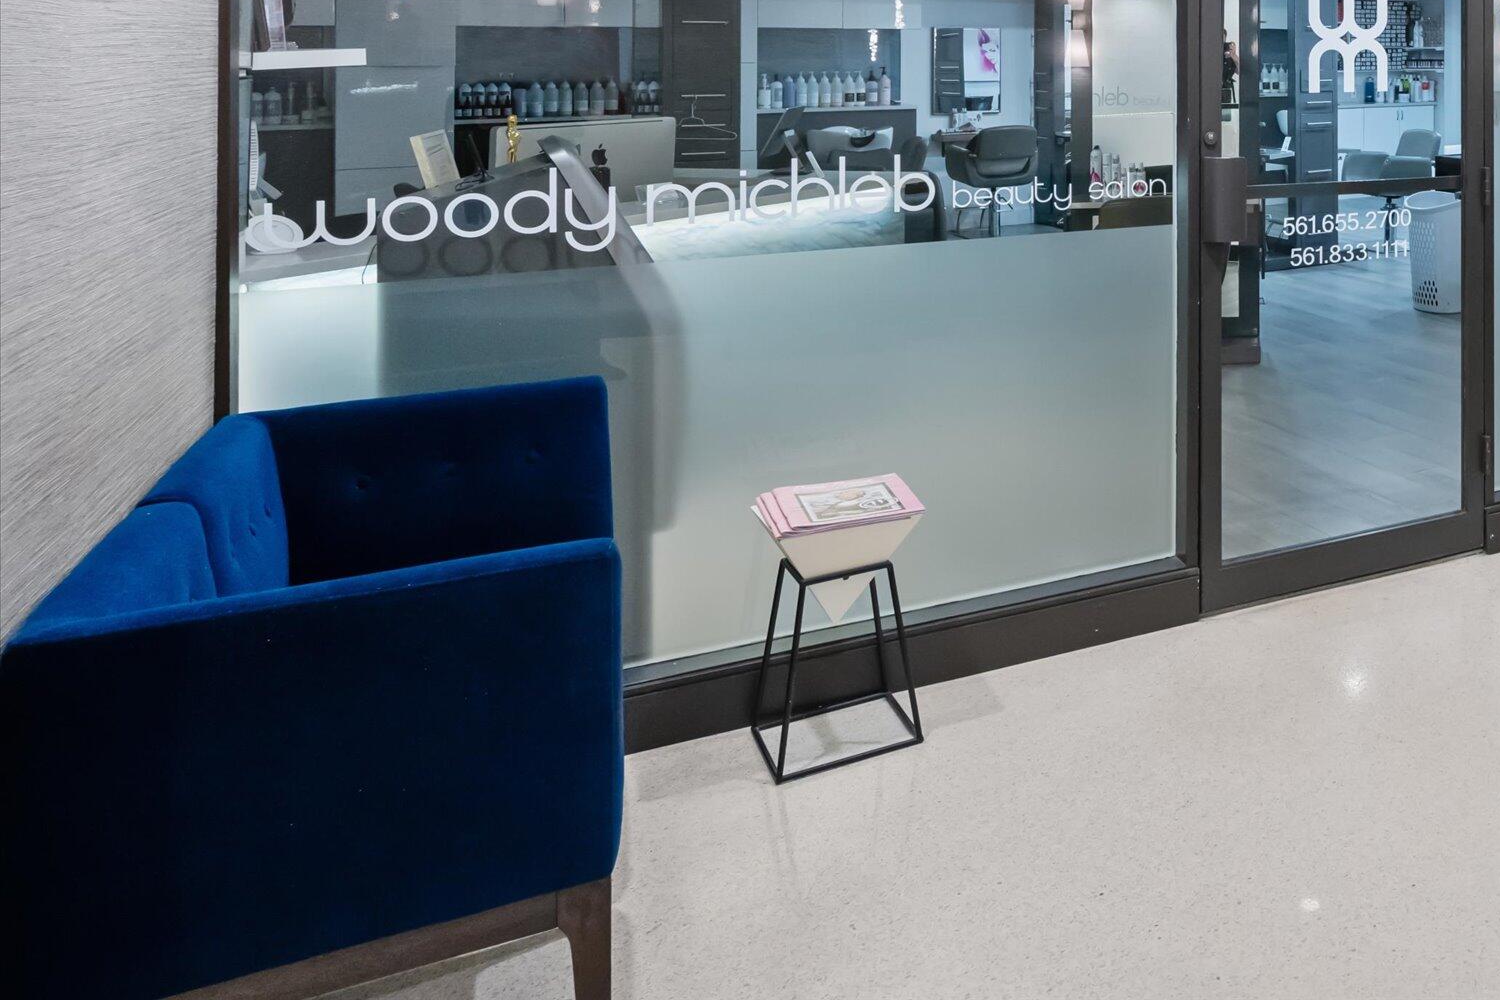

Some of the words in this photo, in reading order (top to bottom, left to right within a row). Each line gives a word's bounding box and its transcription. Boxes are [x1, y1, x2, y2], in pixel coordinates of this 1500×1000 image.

[263, 167, 617, 253] woody
[646, 154, 936, 227] michleb
[952, 176, 1072, 211] beauty
[1088, 170, 1167, 200] salon
[1283, 208, 1412, 236] 561.655.2700
[1290, 239, 1409, 267] 561.833.1111
